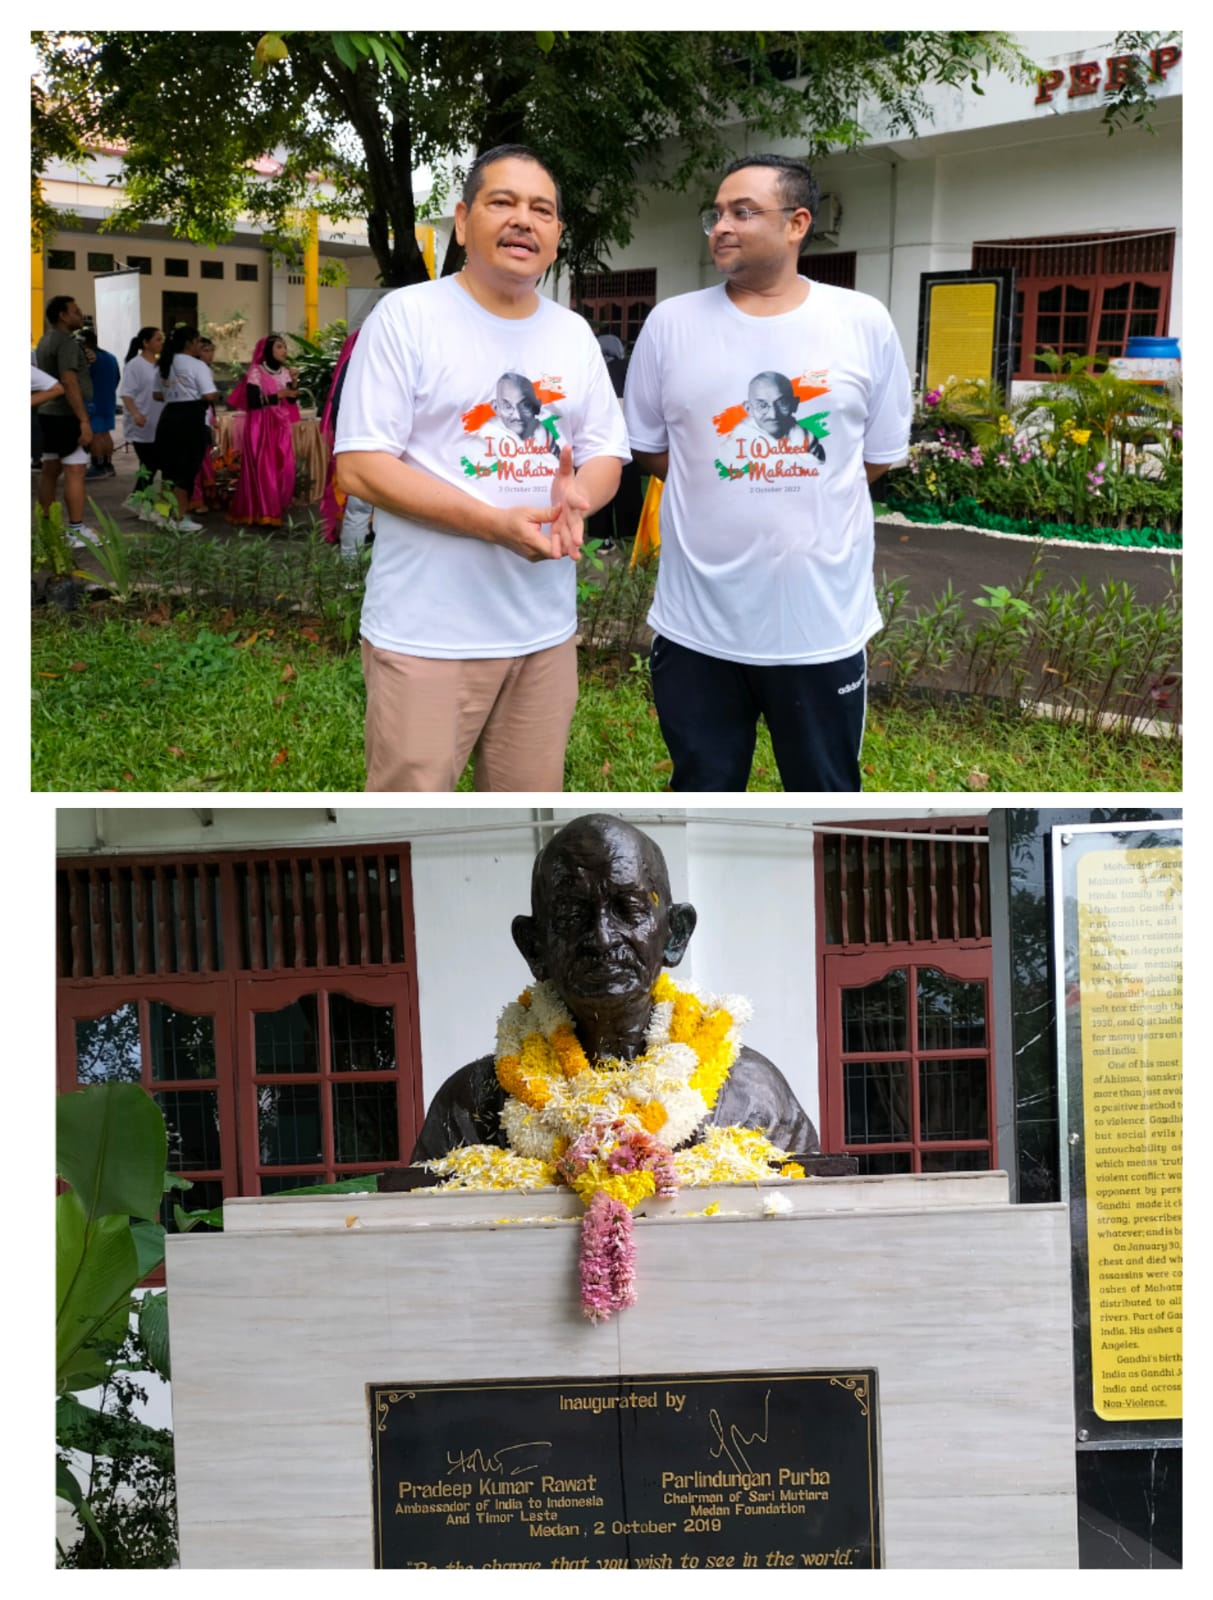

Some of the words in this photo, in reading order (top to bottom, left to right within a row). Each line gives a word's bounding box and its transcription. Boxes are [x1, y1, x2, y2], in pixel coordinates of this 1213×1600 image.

[484, 436, 496, 457] I
[499, 435, 552, 458] Walked
[736, 438, 747, 459] I
[750, 436, 810, 459] Walked
[475, 462, 492, 478] to
[497, 459, 561, 483] Mahatm
[727, 463, 744, 479] to
[748, 459, 820, 483] Mahatma
[1106, 989, 1140, 999] Gandhi
[1117, 1017, 1135, 1027] and
[1092, 1033, 1106, 1042] for
[1108, 1032, 1136, 1043] many
[1165, 1032, 1177, 1040] on
[1092, 1047, 1110, 1056] and
[1108, 1060, 1126, 1070] One
[1128, 1059, 1138, 1068] of
[1156, 1059, 1178, 1068] most
[1094, 1074, 1103, 1084] of
[1094, 1090, 1118, 1098] more
[1120, 1088, 1142, 1097] than
[1102, 1103, 1138, 1114] positive
[1140, 1100, 1176, 1110] method
[1094, 1118, 1104, 1126] to
[1094, 1132, 1112, 1140] but
[1116, 1130, 1146, 1139] social
[1152, 1128, 1176, 1138] evils
[1096, 1144, 1167, 1154] untouchability
[1096, 1159, 1124, 1168] which
[1096, 1172, 1128, 1182] violent
[1130, 1172, 1166, 1181] conflict
[1096, 1188, 1140, 1198] opponent
[1144, 1186, 1156, 1197] by
[1096, 1201, 1130, 1210] Gandhi
[1136, 1199, 1162, 1208] made
[1133, 1213, 1182, 1225] prescribes
[1146, 1227, 1164, 1236] and
[1113, 1243, 1126, 1252] On
[1128, 1242, 1168, 1252] January
[1098, 1257, 1124, 1266] chest
[1126, 1256, 1144, 1266] and
[1146, 1255, 1166, 1264] died
[1099, 1270, 1144, 1280] assassins
[1146, 1270, 1168, 1279] were
[1099, 1284, 1126, 1294] ashes
[1130, 1284, 1140, 1293] of
[1100, 1297, 1152, 1308] distributed
[1156, 1298, 1166, 1306] to
[1133, 1312, 1153, 1320] Part
[1155, 1310, 1165, 1320] of
[1130, 1326, 1144, 1336] His
[1147, 1326, 1174, 1334] ashes
[1101, 1340, 1140, 1352] Angeles.
[1116, 1354, 1158, 1364] Gandhi's
[1102, 1370, 1126, 1379] India
[1128, 1370, 1140, 1378] as
[1140, 1368, 1174, 1378] Gandhi
[1102, 1384, 1127, 1394] India
[1130, 1384, 1148, 1393] and
[1152, 1384, 1182, 1392] across
[559, 1392, 658, 1414] Inaugurated
[666, 1391, 686, 1412] by
[1103, 1398, 1168, 1409] Non-Violence.
[662, 1470, 771, 1491] Parlindungan
[778, 1468, 830, 1486] Purba
[398, 1480, 472, 1499] Pradeep
[480, 1478, 534, 1496] Kumar
[542, 1474, 598, 1494] Rawat
[664, 1492, 724, 1505] Chairman
[729, 1491, 742, 1502] of
[749, 1490, 776, 1502] Sari
[780, 1488, 829, 1502] Mutiara
[395, 1501, 470, 1515] Ambassador
[476, 1500, 489, 1512] of
[495, 1498, 523, 1511] India
[528, 1498, 542, 1509] to
[547, 1496, 604, 1509] Indonesia
[690, 1504, 730, 1517] Medan
[736, 1502, 806, 1516] Foundation
[446, 1512, 470, 1526] And
[476, 1511, 514, 1524] Timor
[520, 1510, 558, 1522] Leste
[594, 1521, 606, 1535] 2
[612, 1520, 677, 1535] October
[684, 1518, 722, 1533] 2019
[551, 1556, 590, 1570] that
[634, 1552, 673, 1570] wish
[680, 1552, 700, 1568] to
[705, 1554, 736, 1568] see
[743, 1552, 758, 1568] in
[766, 1550, 796, 1567] the
